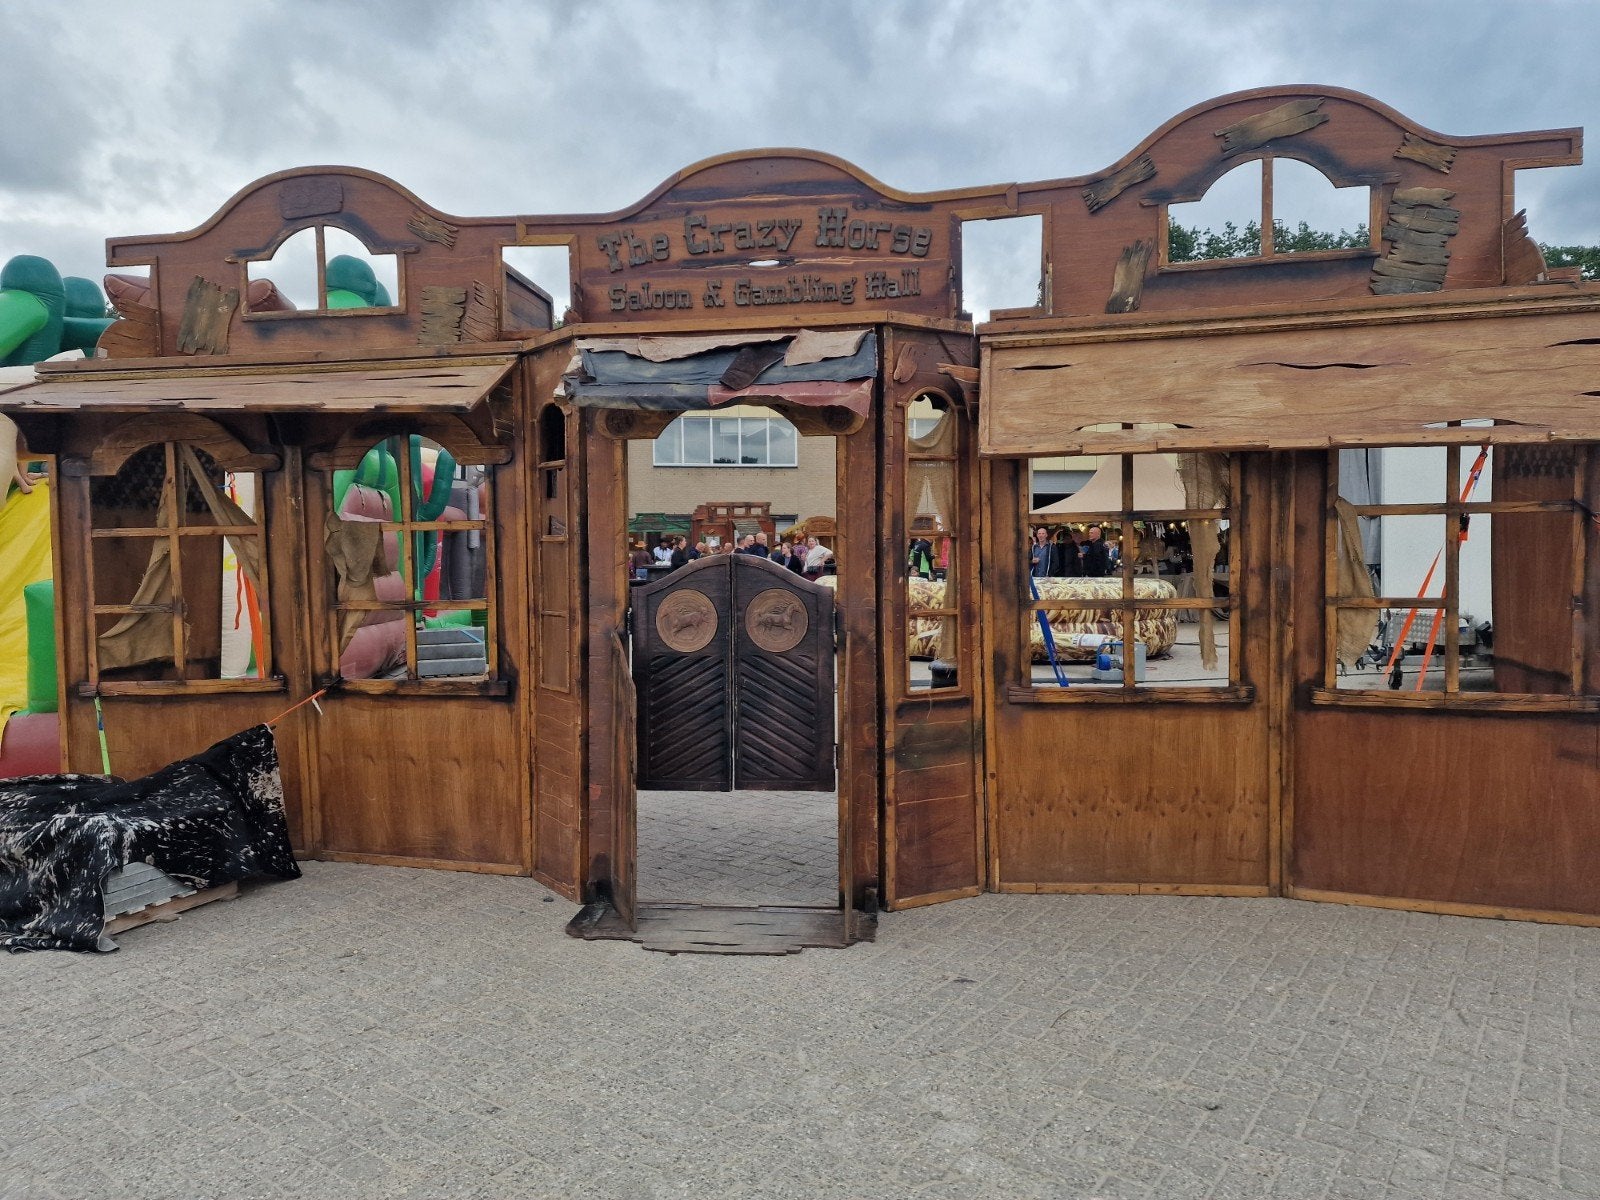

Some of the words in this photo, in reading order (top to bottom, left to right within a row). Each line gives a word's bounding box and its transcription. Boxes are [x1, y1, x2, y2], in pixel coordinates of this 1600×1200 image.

[597, 228, 670, 273] The
[682, 214, 802, 254] Crazy
[815, 206, 933, 257] Horse
[607, 282, 693, 311] Saloon
[703, 279, 726, 308] &
[734, 274, 858, 305] Gambling
[864, 267, 921, 299] Hall
